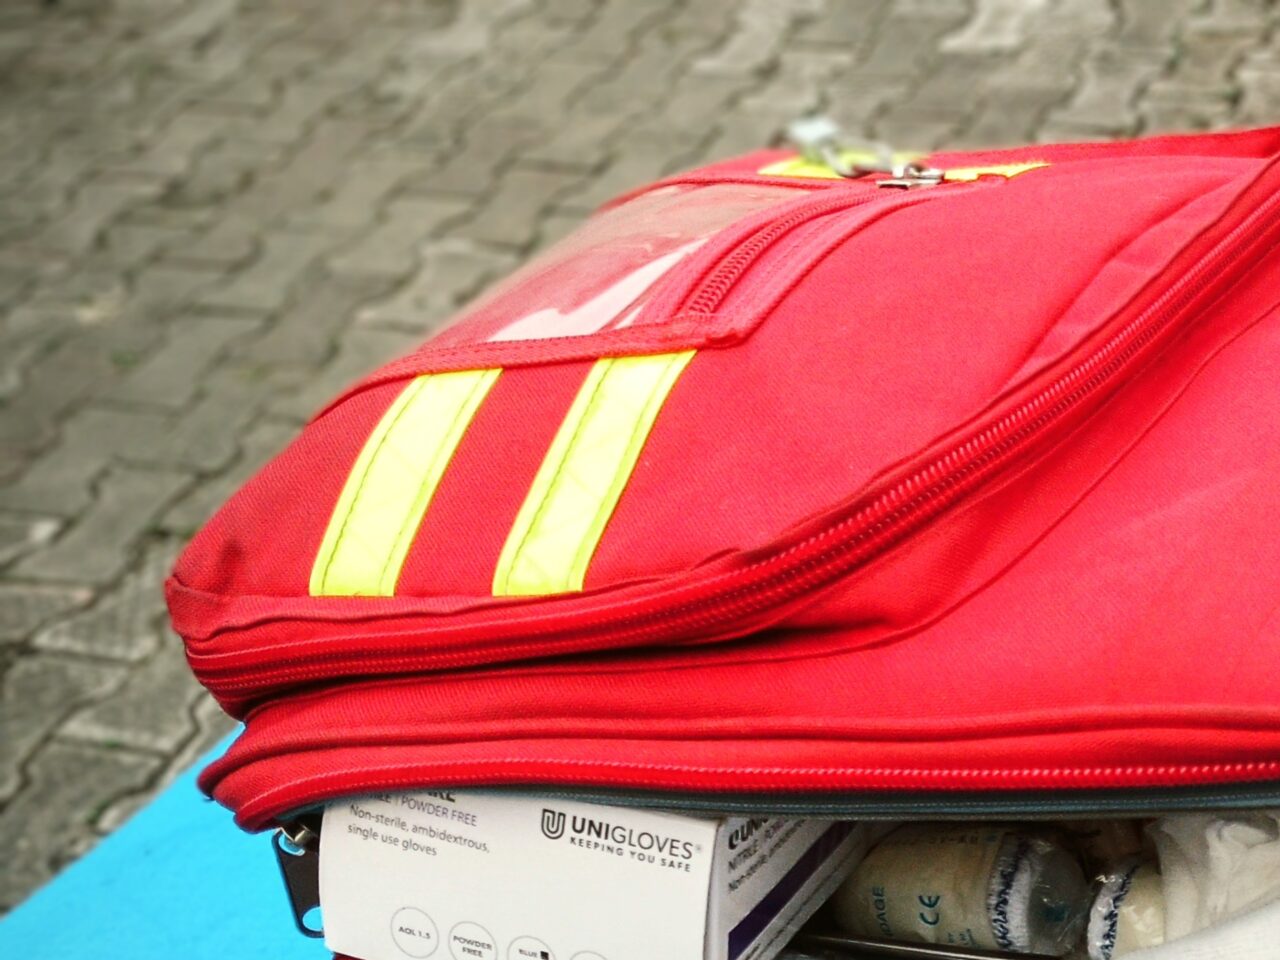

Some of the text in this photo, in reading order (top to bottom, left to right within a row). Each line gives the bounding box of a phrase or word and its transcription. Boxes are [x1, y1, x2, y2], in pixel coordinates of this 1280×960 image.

[402, 796, 449, 818] POWDER
[451, 810, 477, 827] FREE
[348, 823, 437, 856] single use gloves
[350, 805, 490, 853] Non-sterile, ambidextrous,
[570, 836, 691, 873] KEEPING YOU SAFE
[453, 935, 493, 951] POWDER
[462, 946, 484, 958] FREE
